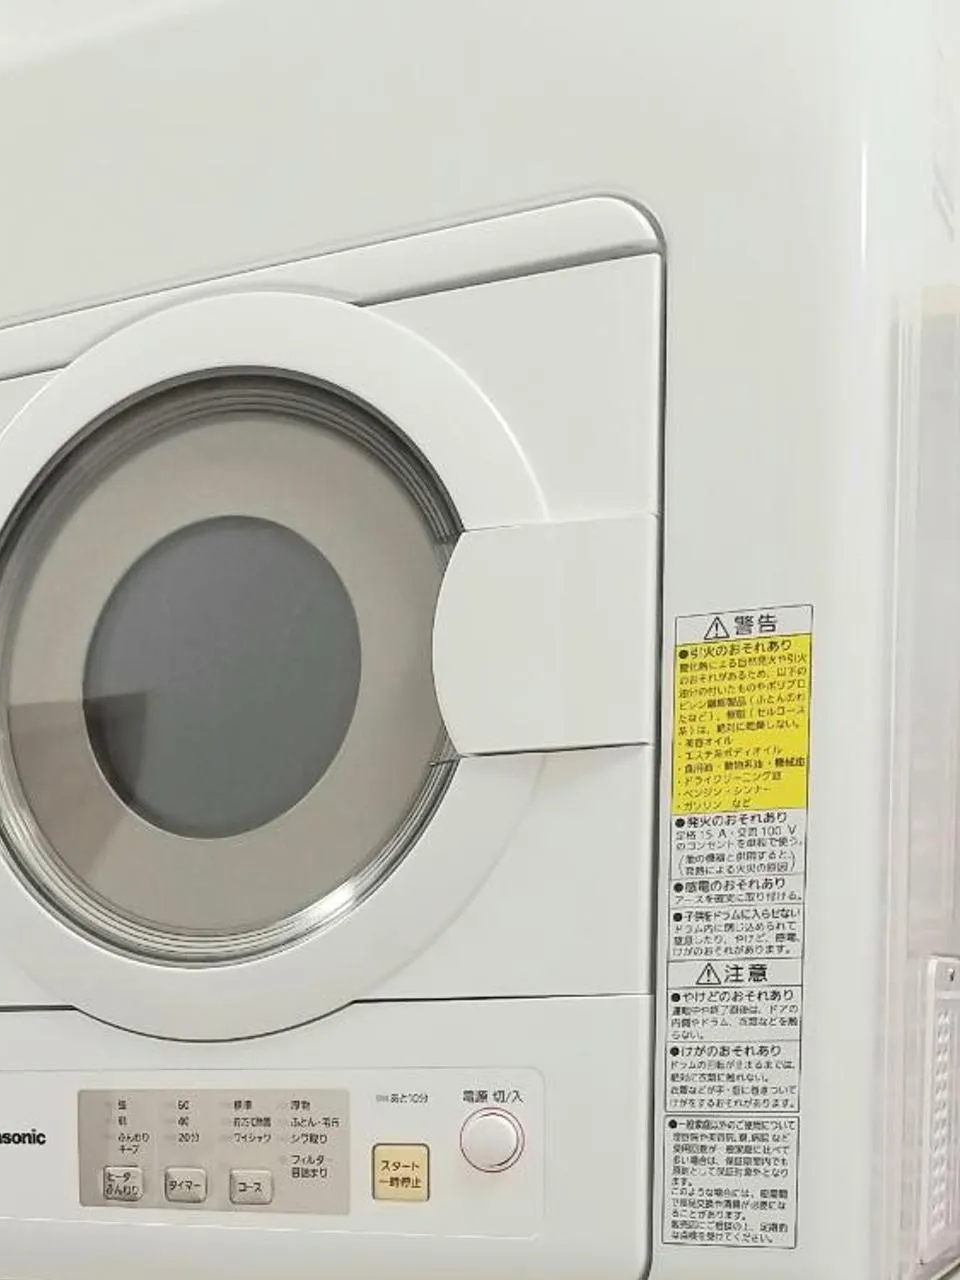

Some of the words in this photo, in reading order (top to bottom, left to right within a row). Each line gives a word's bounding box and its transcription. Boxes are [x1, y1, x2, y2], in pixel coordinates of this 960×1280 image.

[734, 613, 778, 635] 警告
[690, 640, 792, 658] 引火のおそれあり
[687, 812, 787, 828] 発火のおそれあり
[685, 878, 785, 893] 感電のおそれあり
[724, 963, 768, 982] 注意
[682, 989, 793, 1002] やけどのおそれあり
[681, 1046, 781, 1057] けがのおそれあり
[463, 1090, 488, 1103] 電源
[492, 1090, 524, 1103] 切/入
[380, 1160, 420, 1172] スタート
[238, 1182, 262, 1192] コース
[379, 1176, 422, 1189] 一時停止
